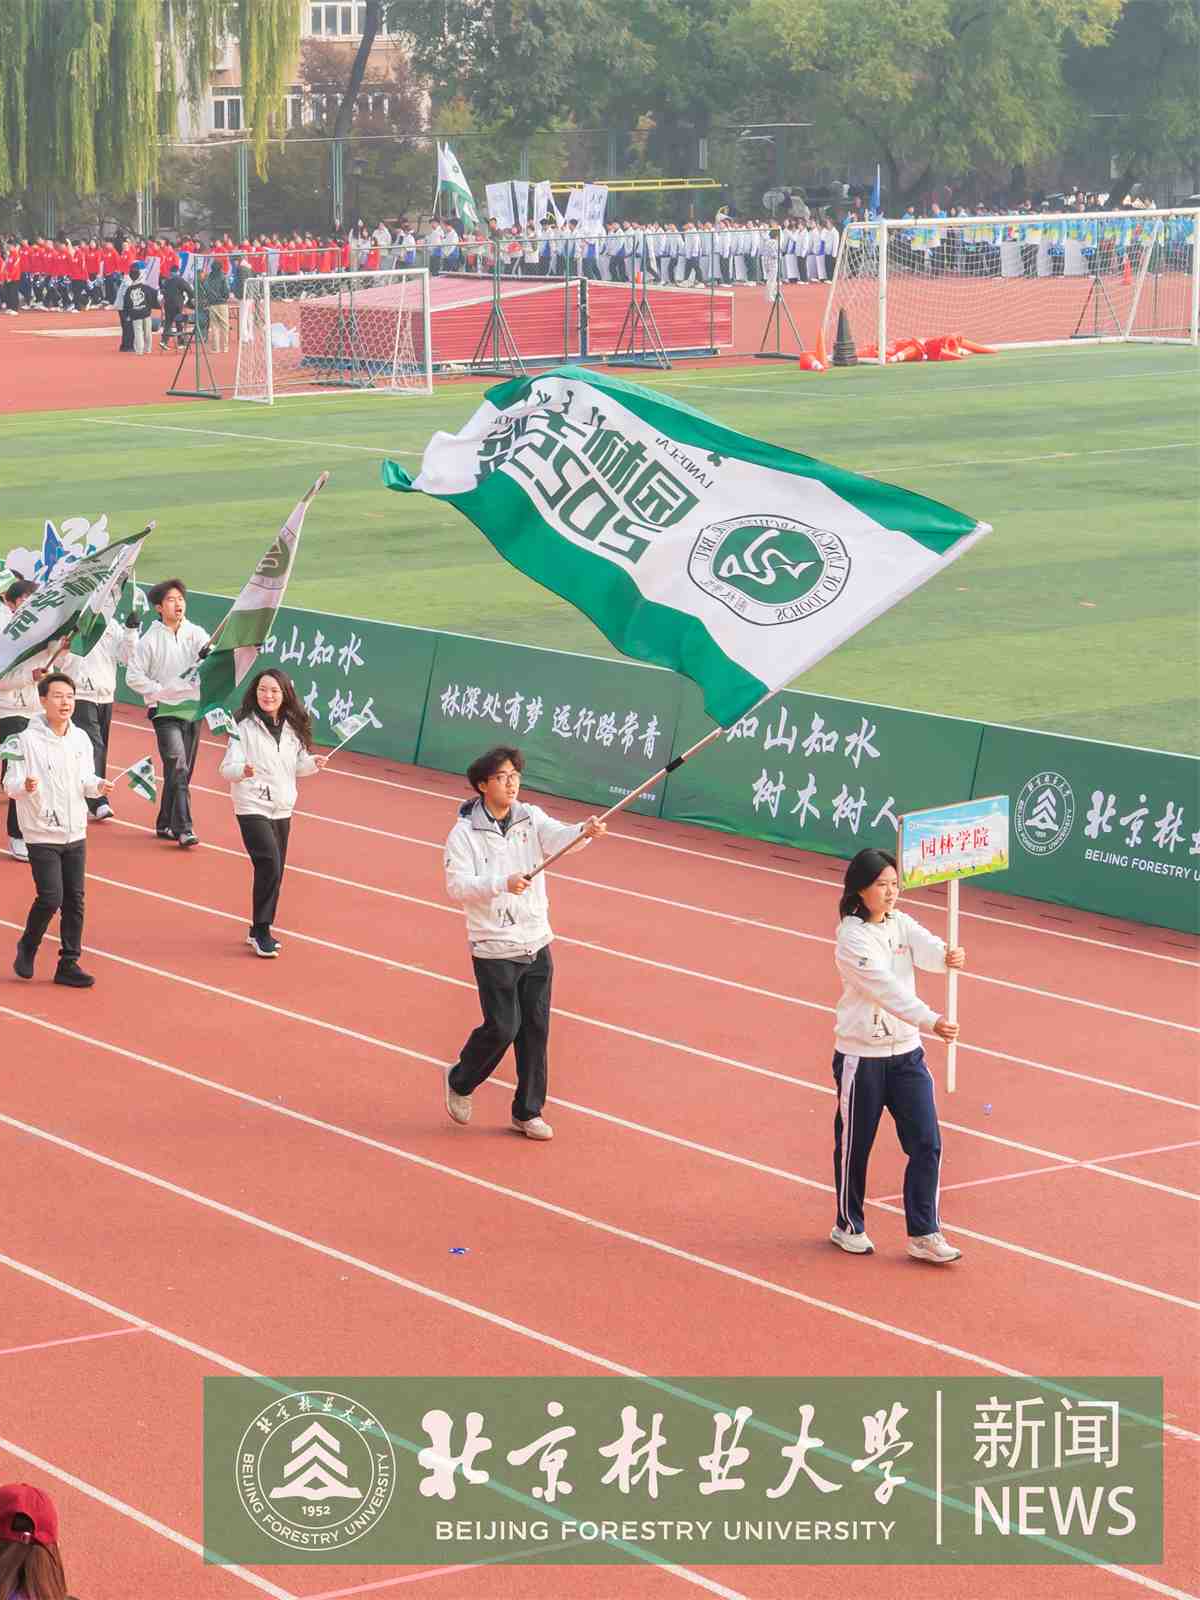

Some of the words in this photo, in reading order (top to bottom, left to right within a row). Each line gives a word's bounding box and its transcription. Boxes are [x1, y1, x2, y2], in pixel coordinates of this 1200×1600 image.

[440, 684, 544, 733] 林深处有梦
[552, 704, 661, 759] 远行路常青
[752, 768, 899, 835] 树木树人
[921, 827, 989, 862] 园林学院
[1085, 849, 1129, 867] BEIJING
[1131, 858, 1191, 880] FORESTRY
